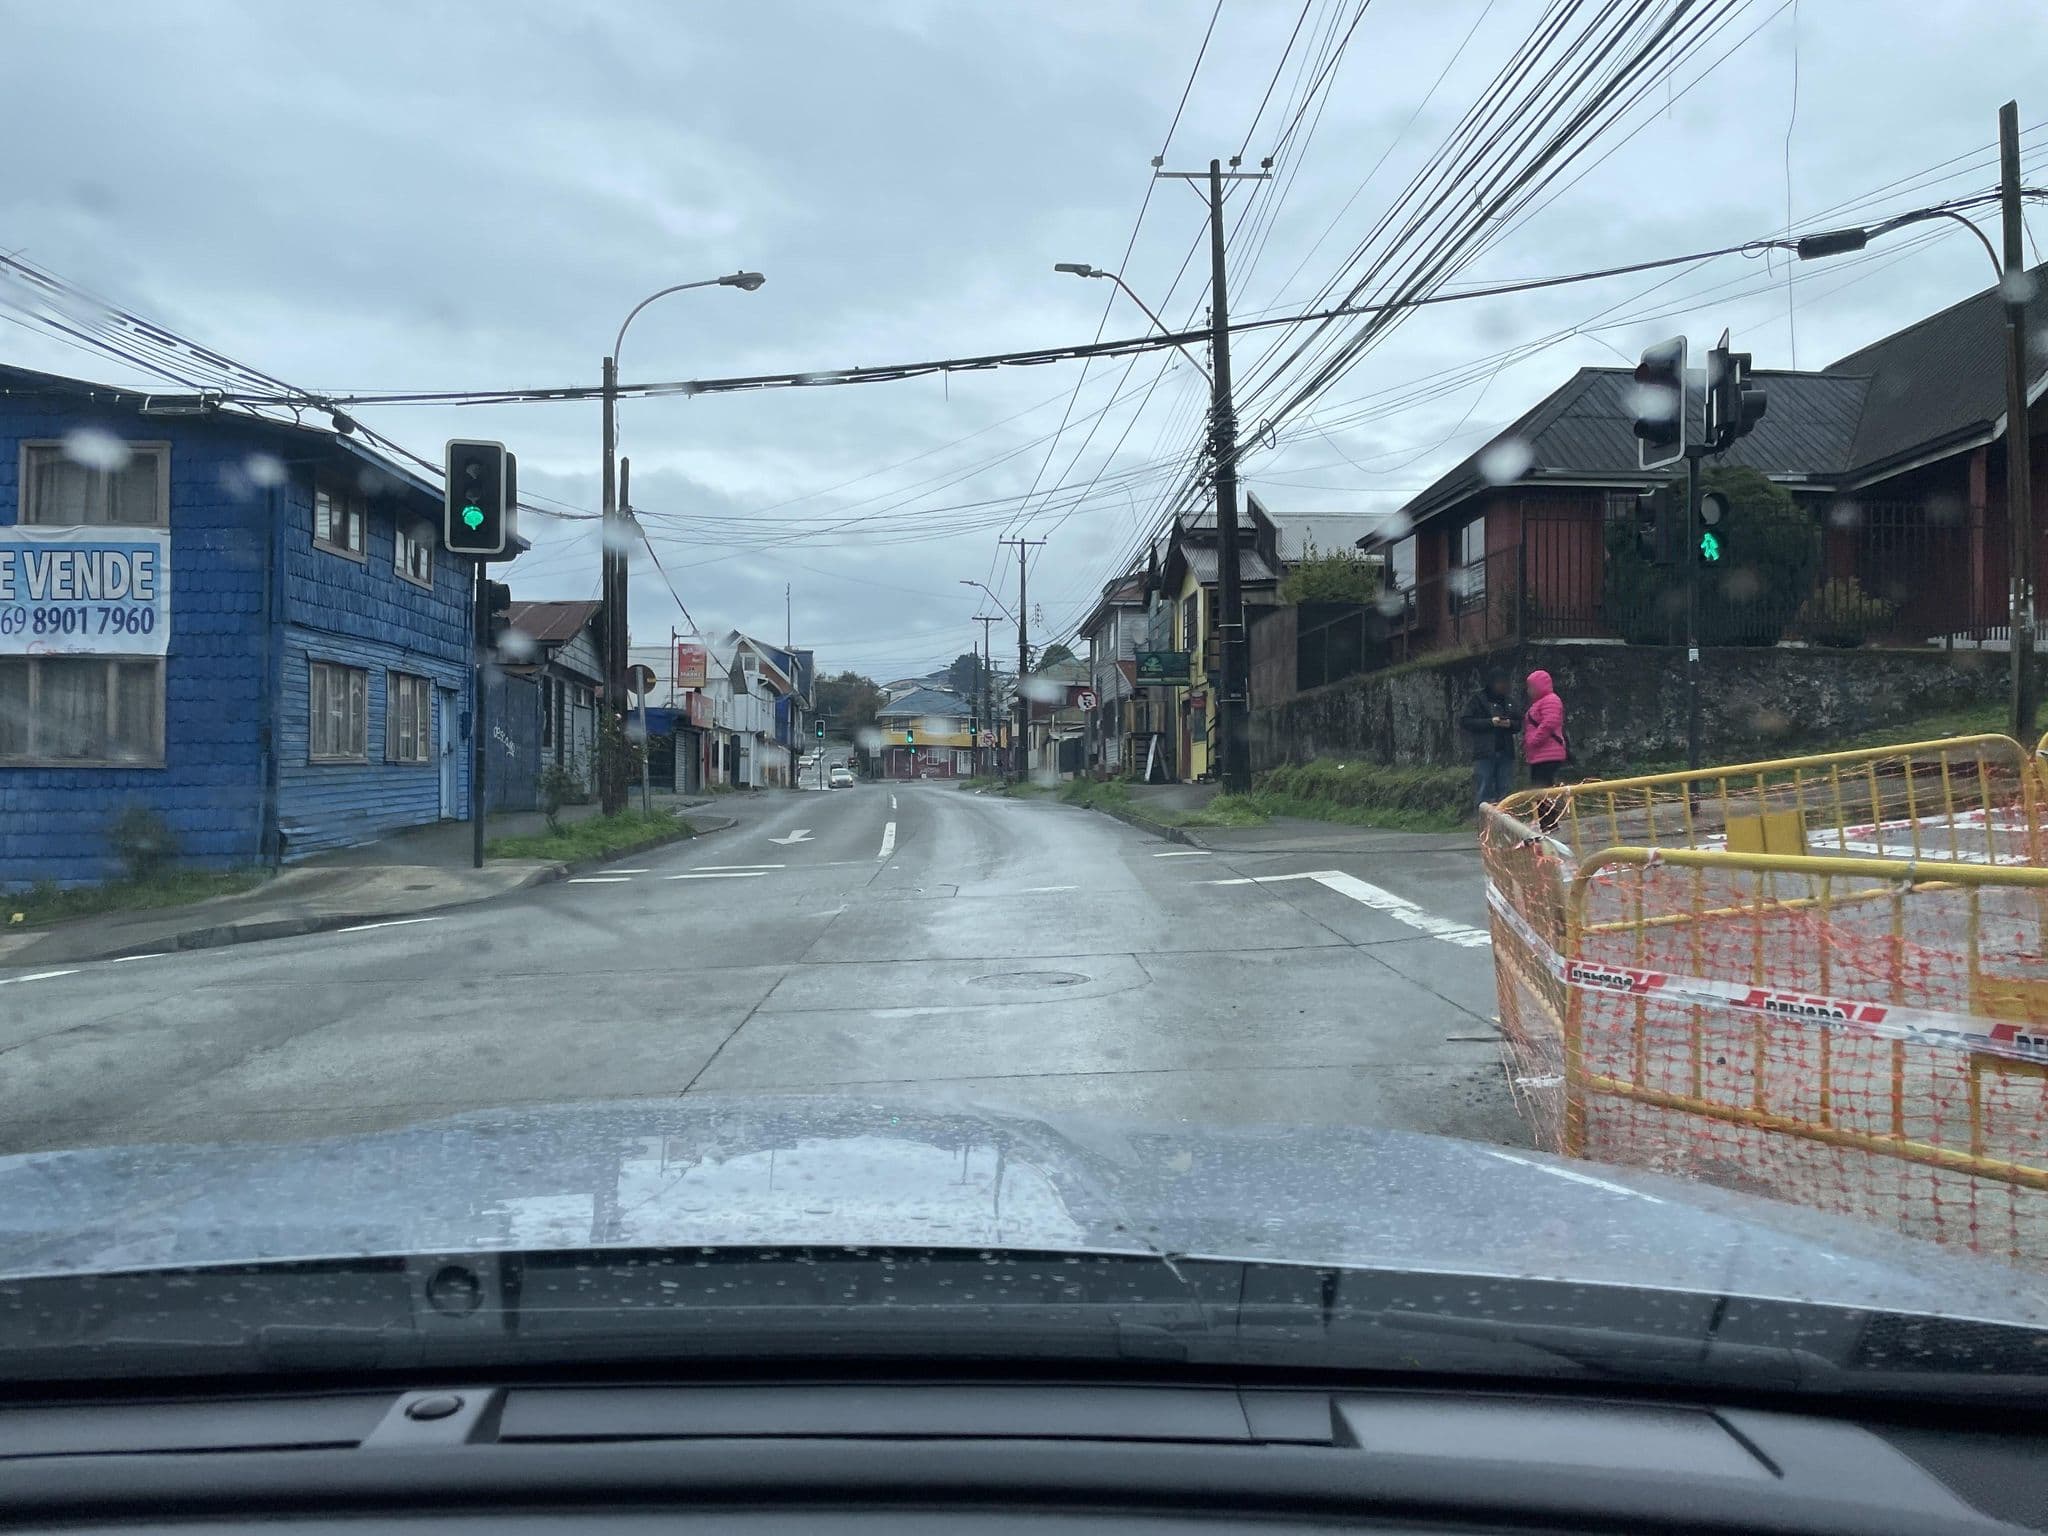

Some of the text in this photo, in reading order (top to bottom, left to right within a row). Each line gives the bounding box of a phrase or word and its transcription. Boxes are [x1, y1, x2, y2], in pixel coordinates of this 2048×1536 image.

[22, 550, 155, 601] VENDE
[1, 606, 155, 635] 69 8901 7960
